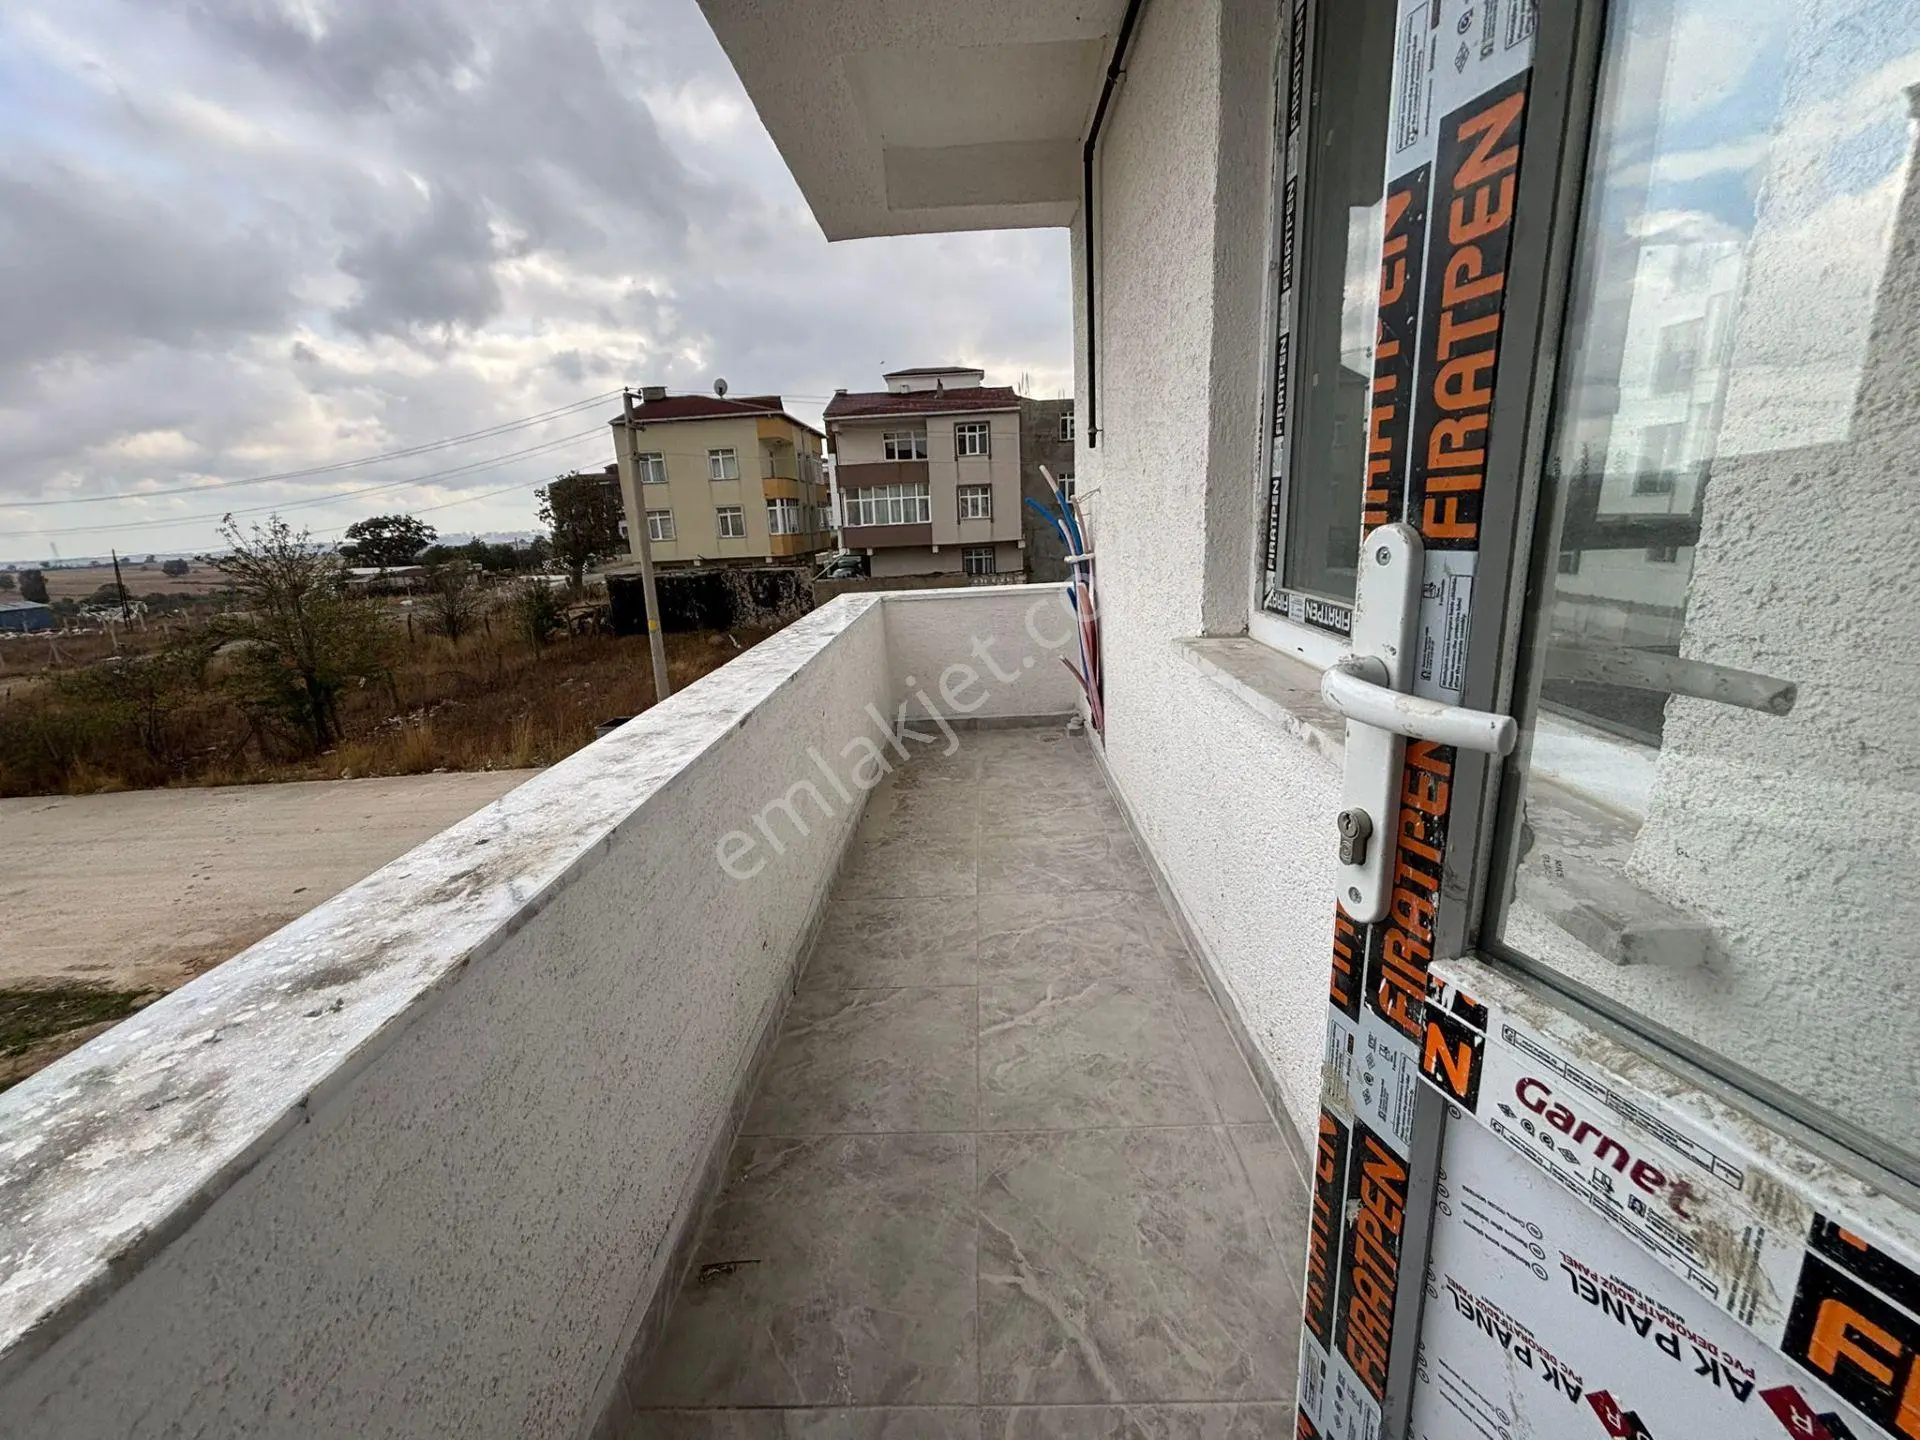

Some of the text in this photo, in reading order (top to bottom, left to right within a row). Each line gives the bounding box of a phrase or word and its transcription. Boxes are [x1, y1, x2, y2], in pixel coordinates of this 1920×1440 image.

[1283, 185, 1297, 288] FIRATPEN
[1420, 90, 1527, 541] FIRATPEN
[1275, 338, 1289, 436] FIRATPEN
[1267, 479, 1281, 570] FIRATPEN
[1305, 601, 1351, 632] FIRATPEN
[1378, 738, 1451, 1038] FIRATPEN
[1515, 1077, 1694, 1221] Garnet
[1347, 1135, 1407, 1401] FIRATPEN
[1559, 1250, 1598, 1283] PANEL
[1609, 1274, 1643, 1297] TURKEY
[1446, 1284, 1533, 1370] PANEL
[1560, 1262, 1682, 1362] PANEL
[1654, 1305, 1685, 1325] MADE
[1540, 1357, 1582, 1404] AK
[1560, 1362, 1584, 1386] PVC
[1692, 1346, 1755, 1404] AK
[1721, 1352, 1756, 1381] PVC
